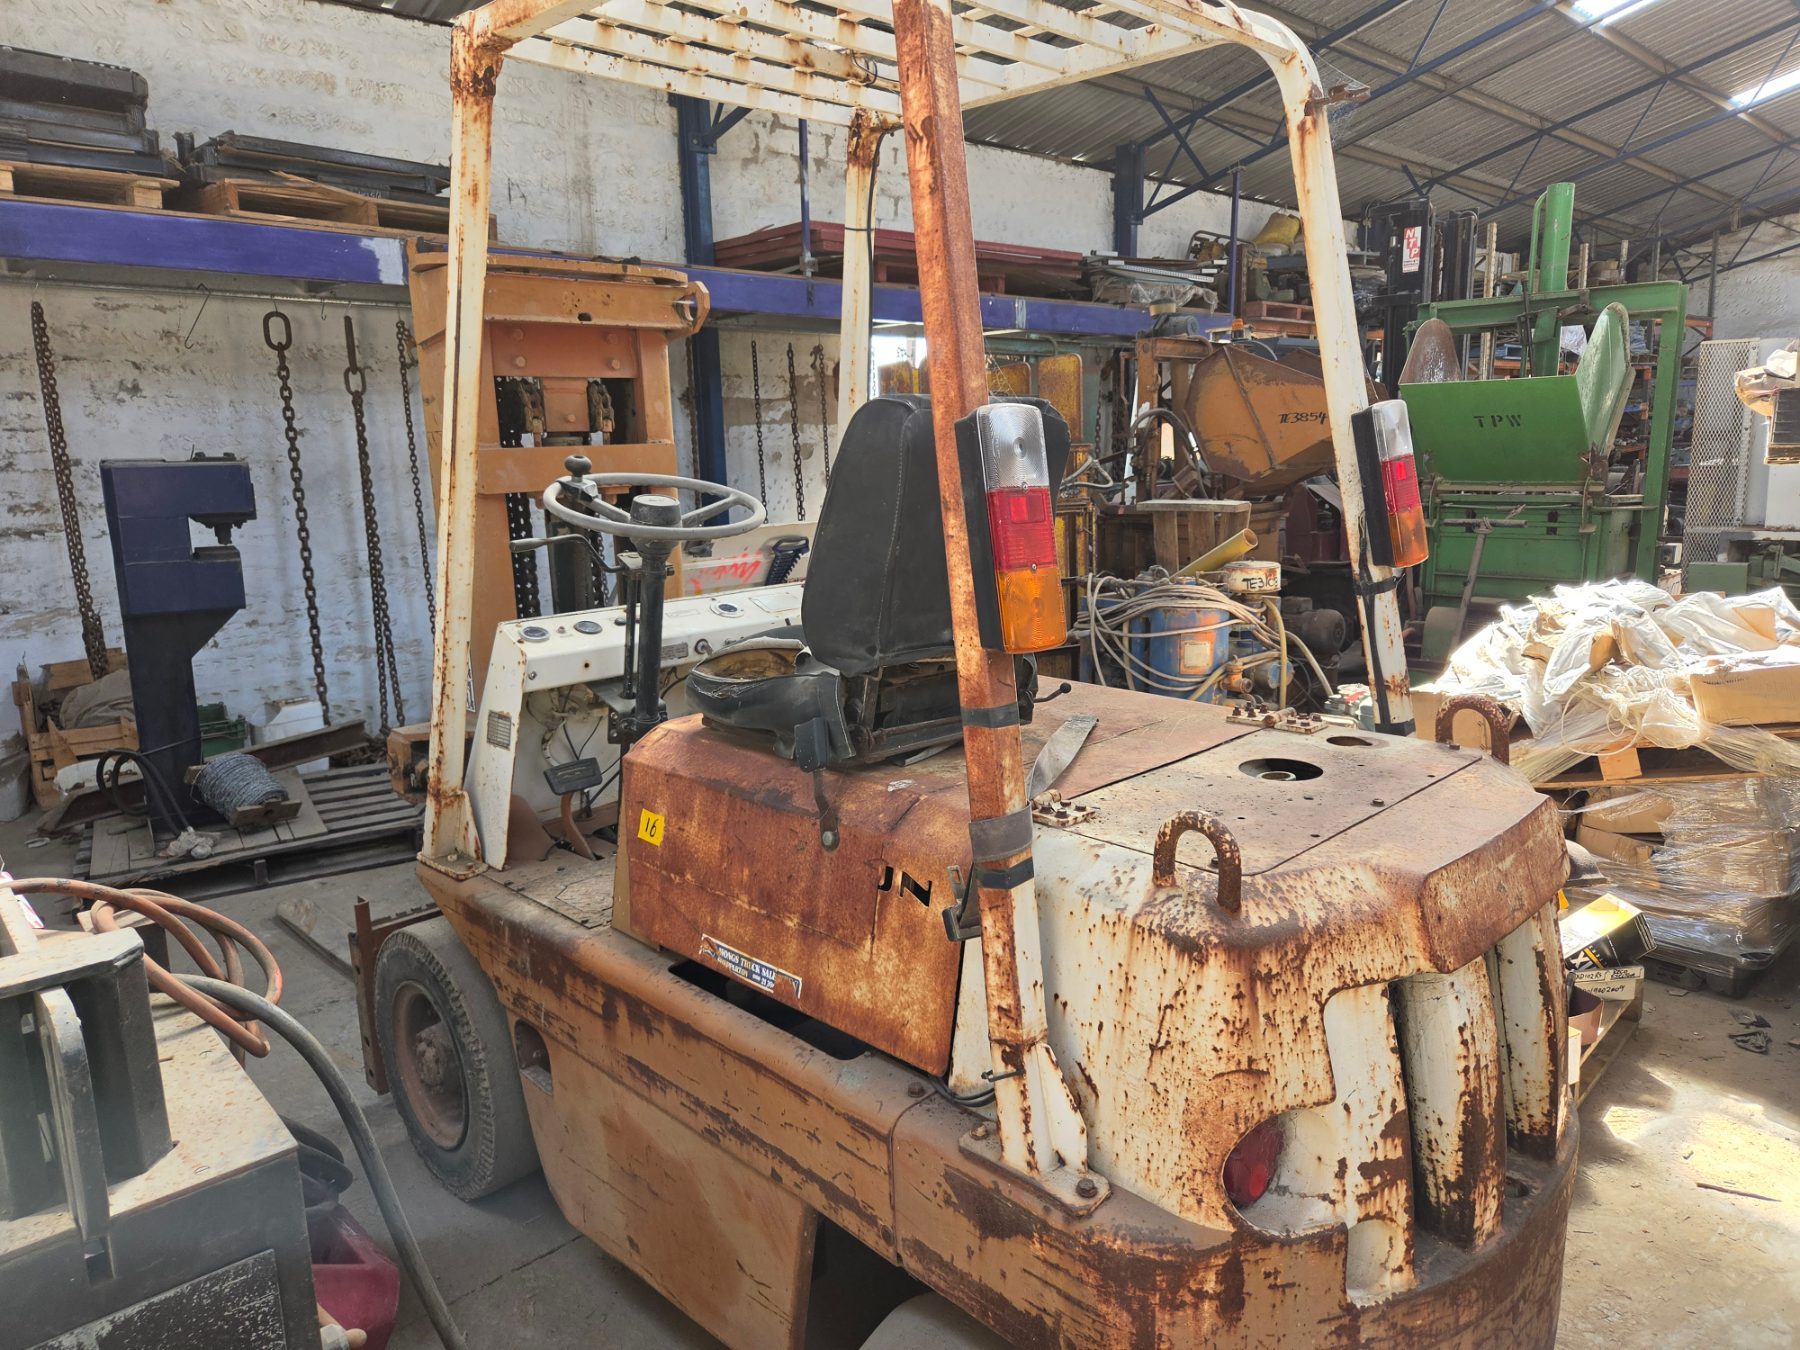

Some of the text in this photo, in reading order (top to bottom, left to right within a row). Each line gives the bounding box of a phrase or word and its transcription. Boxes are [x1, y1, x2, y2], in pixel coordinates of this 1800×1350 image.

[1404, 227, 1420, 259] NTP
[1473, 414, 1521, 428] TPW
[645, 817, 660, 838] 16
